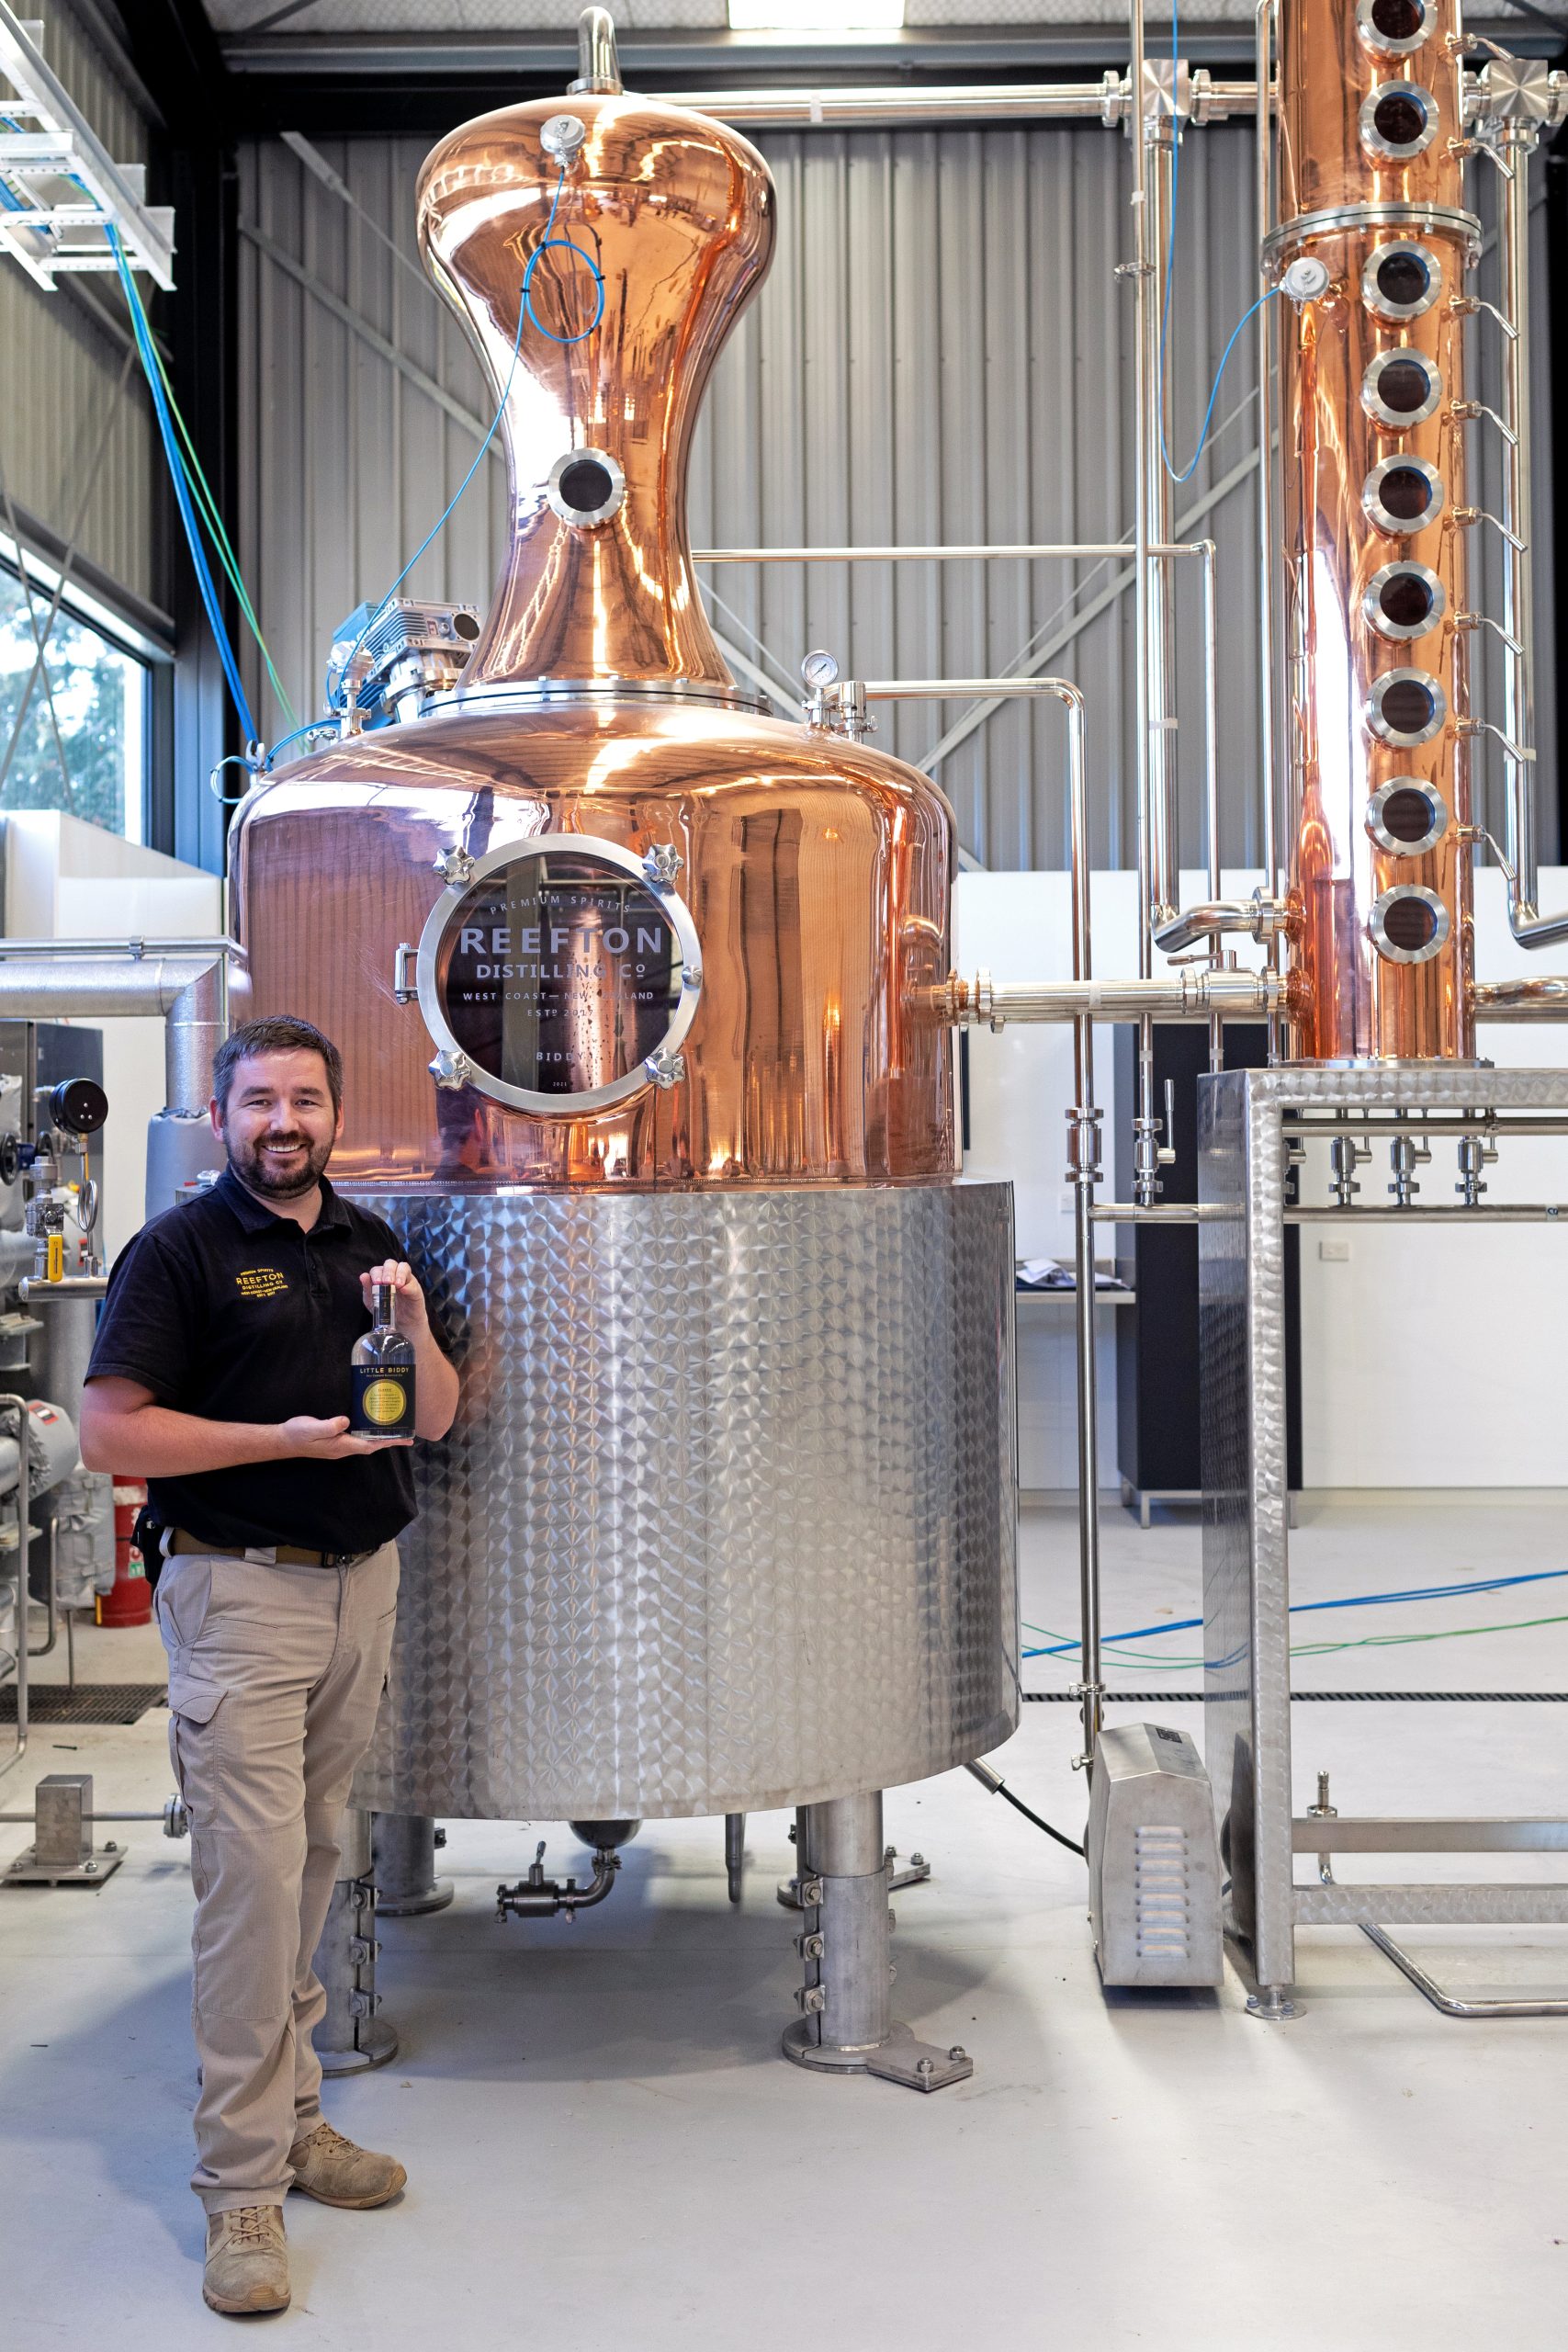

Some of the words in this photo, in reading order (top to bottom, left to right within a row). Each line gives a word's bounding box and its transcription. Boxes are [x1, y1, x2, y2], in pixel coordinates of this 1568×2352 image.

[490, 896, 560, 915] PREMIUM
[570, 896, 630, 913] SPIRITS
[460, 927, 661, 954] REEFTON
[476, 964, 606, 978] DISTILLING
[462, 991, 497, 1001] WEST
[602, 991, 654, 1001] ZALAND
[536, 1051, 584, 1062] BIDDY
[235, 1272, 285, 1285] REEFTON
